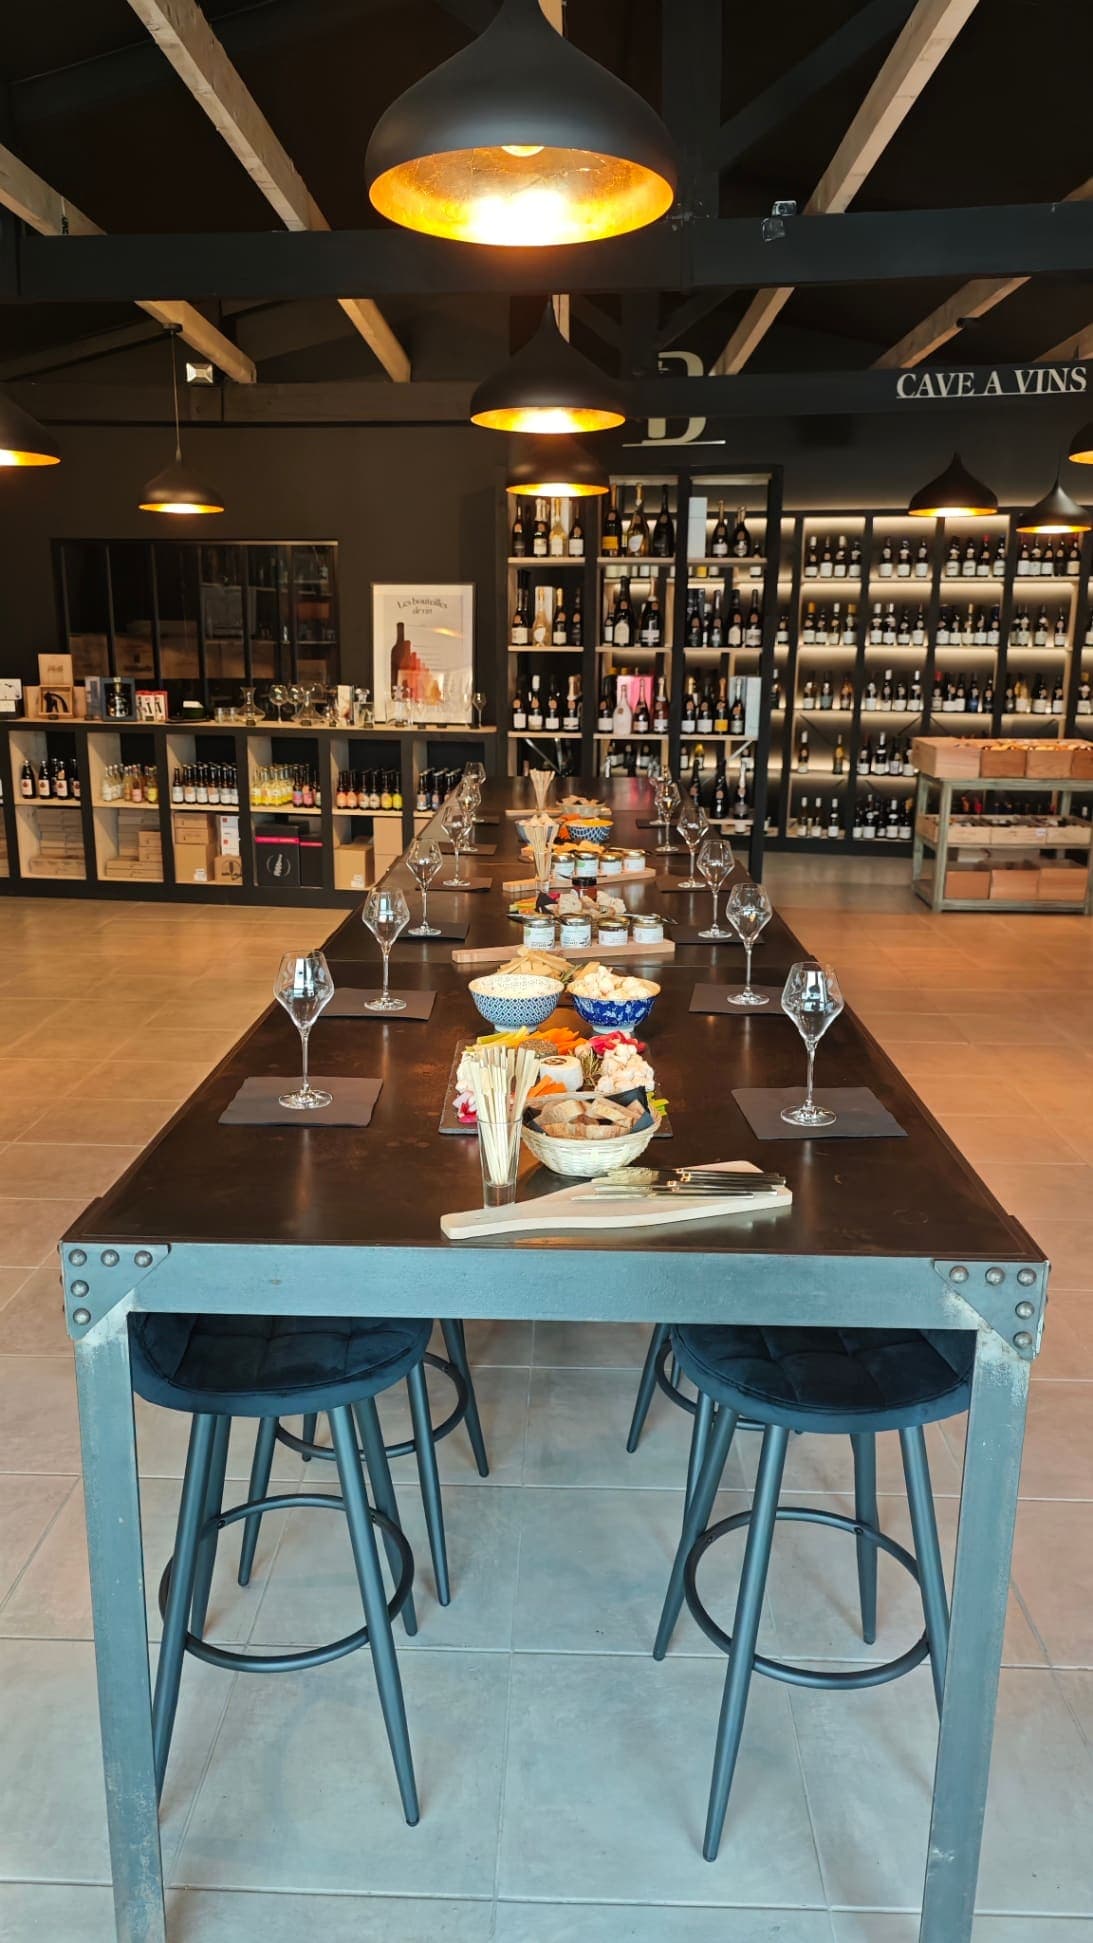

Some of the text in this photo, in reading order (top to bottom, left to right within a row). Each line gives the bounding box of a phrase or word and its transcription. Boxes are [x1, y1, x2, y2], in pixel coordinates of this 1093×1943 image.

[896, 366, 1087, 398] CAVE A VINS
